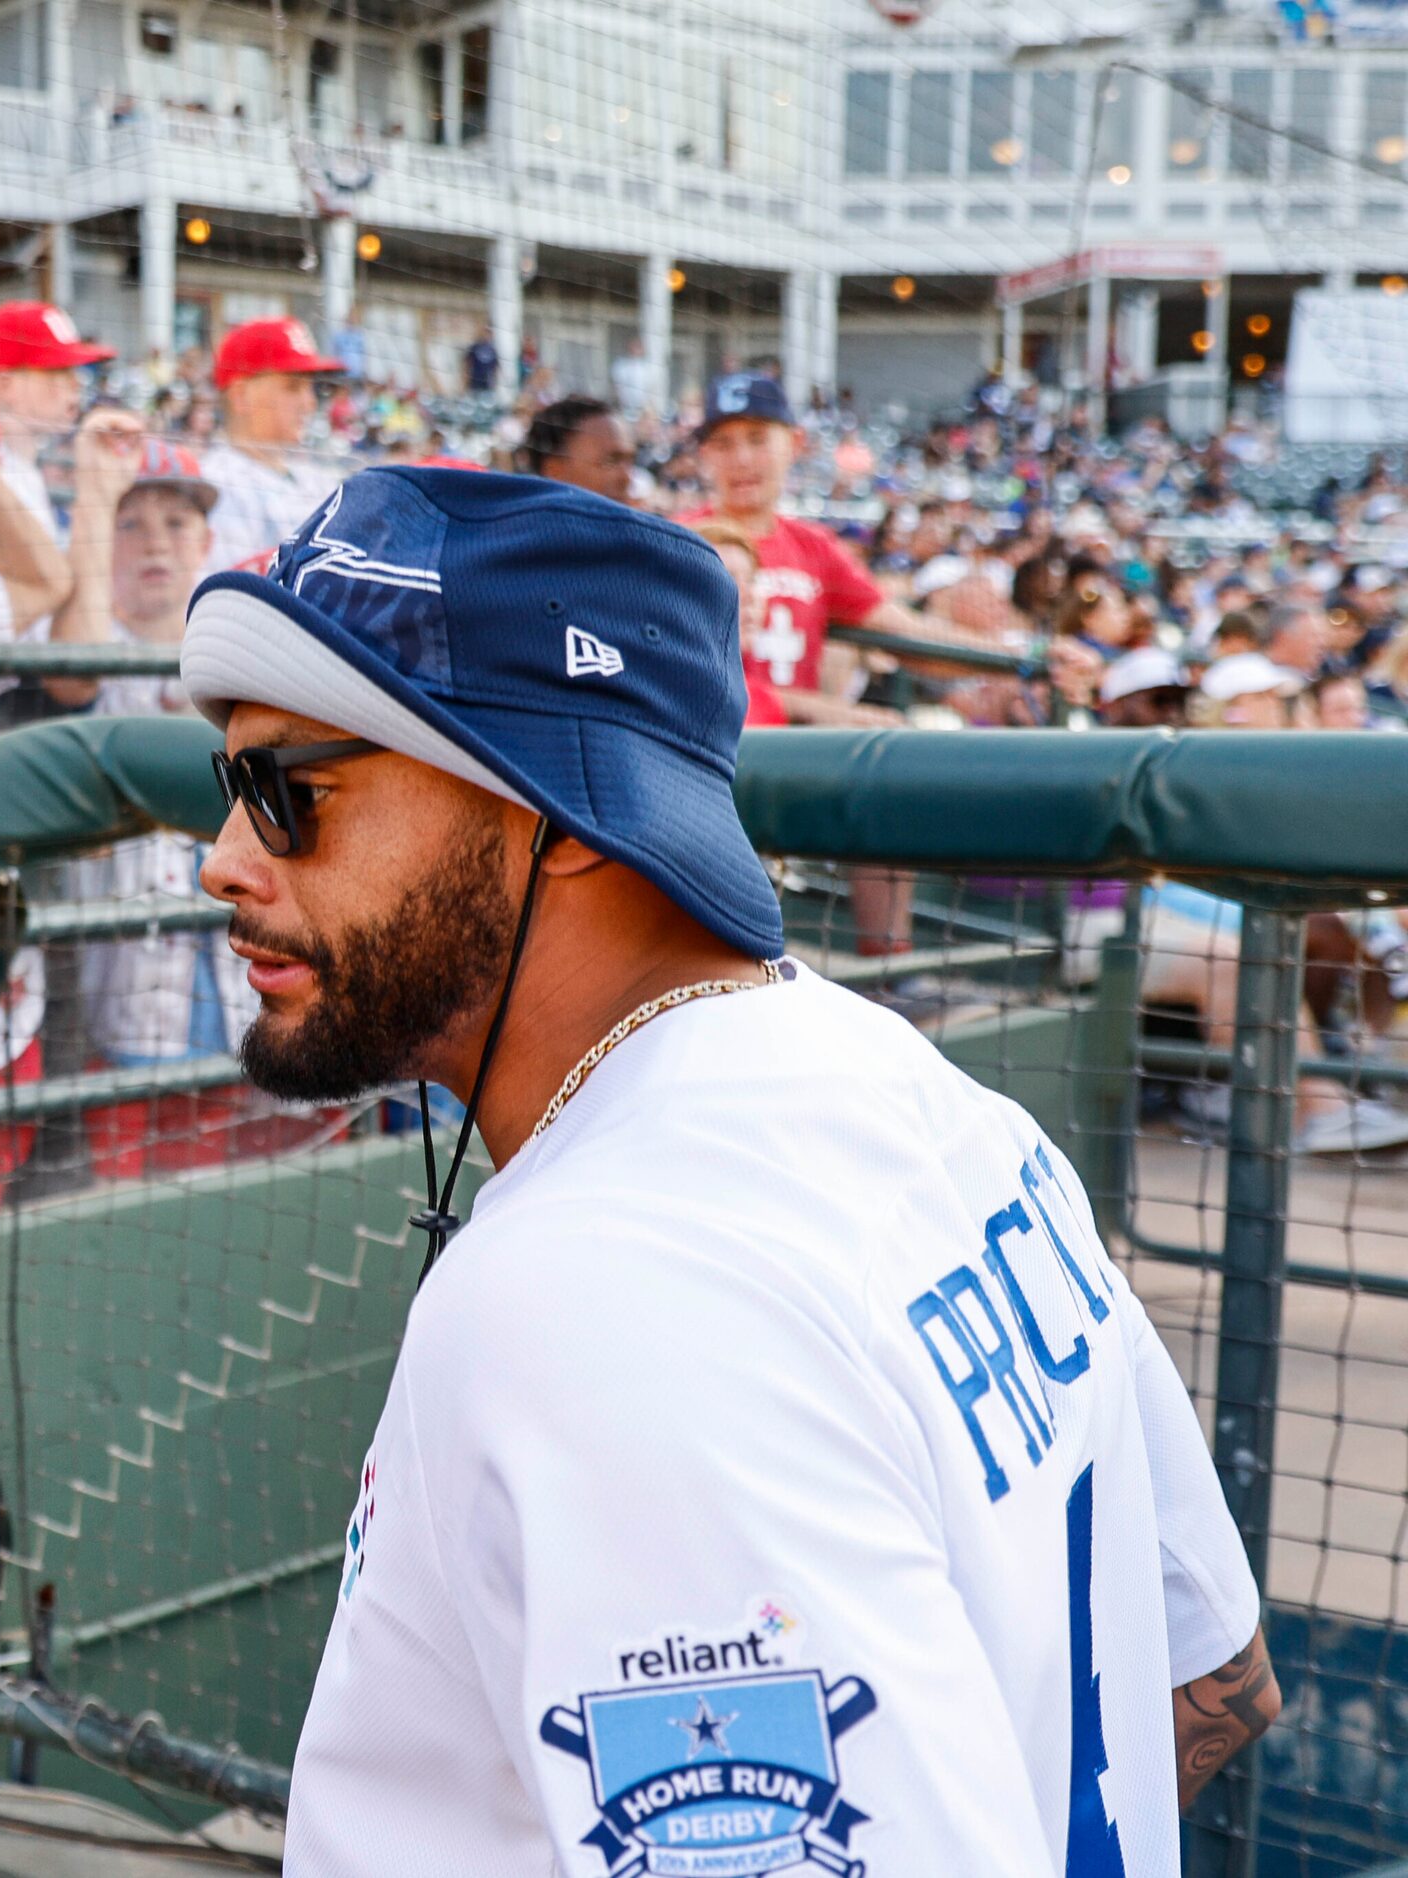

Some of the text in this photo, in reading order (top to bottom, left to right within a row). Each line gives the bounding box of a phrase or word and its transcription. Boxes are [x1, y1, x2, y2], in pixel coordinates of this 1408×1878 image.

[621, 1766, 814, 1823] HOME RUN
[666, 1808, 777, 1844] DERBY
